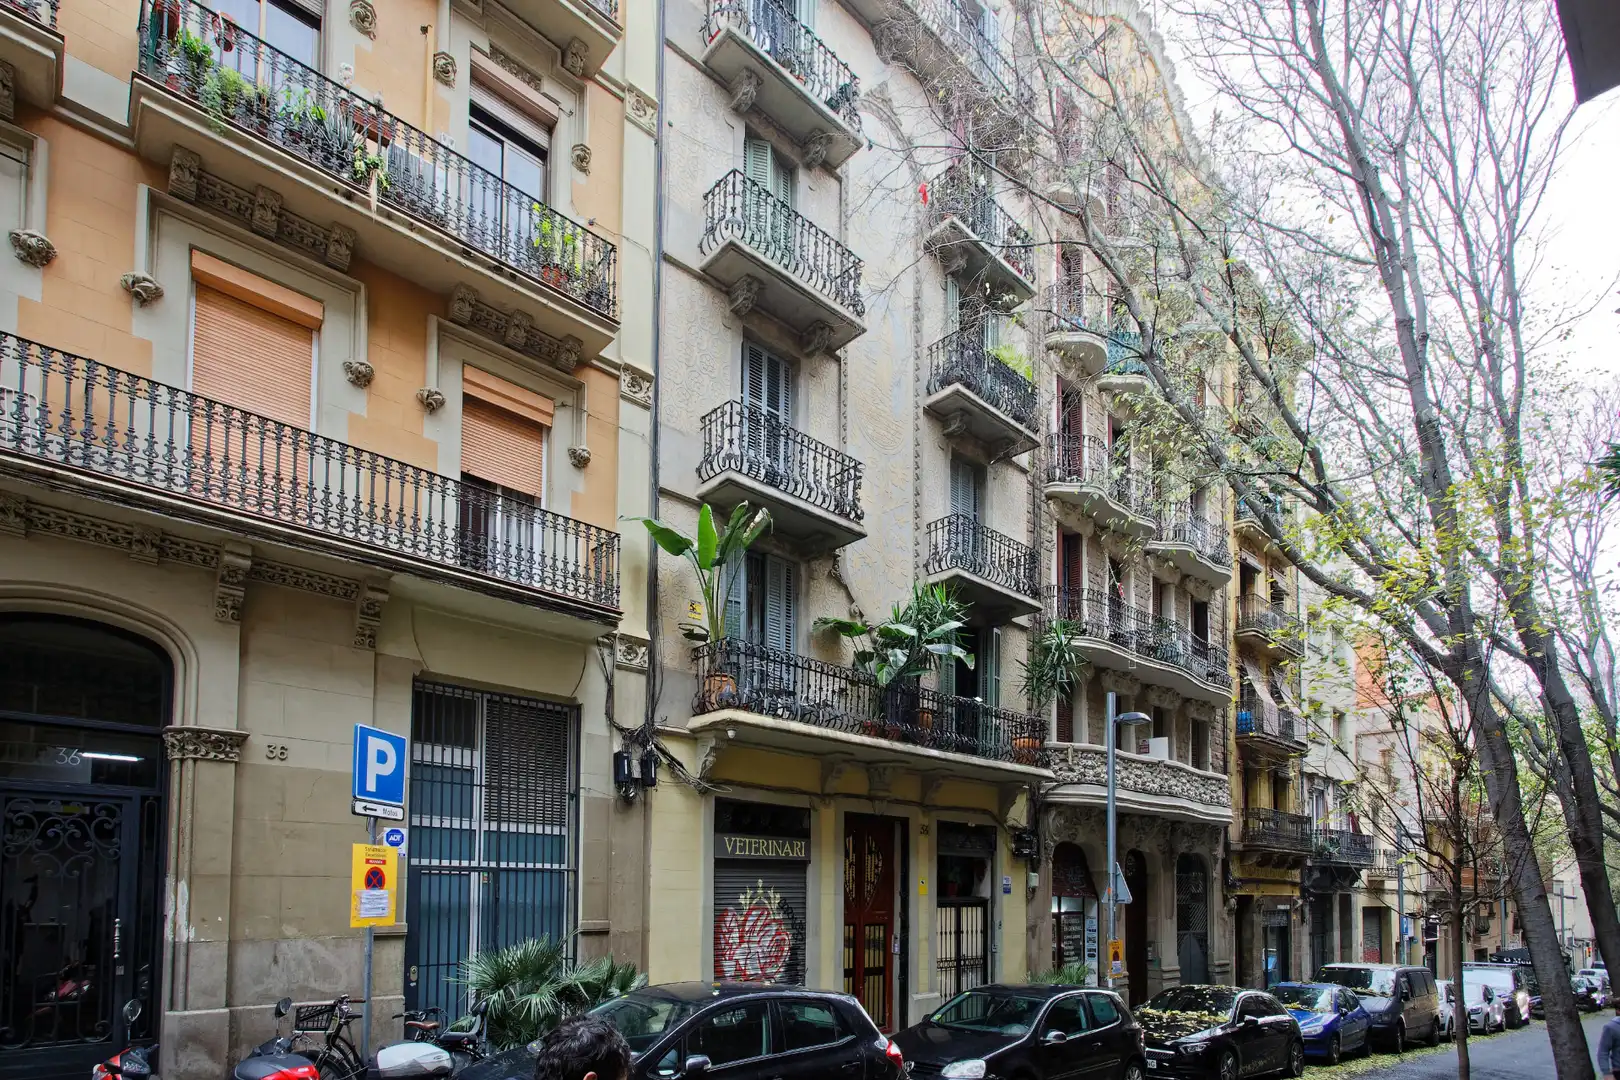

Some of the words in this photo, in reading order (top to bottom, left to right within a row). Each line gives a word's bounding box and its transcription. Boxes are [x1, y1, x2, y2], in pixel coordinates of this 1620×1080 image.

[55, 747, 81, 766] 36
[265, 743, 289, 760] 36
[366, 736, 396, 792] P
[388, 833, 402, 842] ADT
[724, 836, 806, 857] VETERINARI
